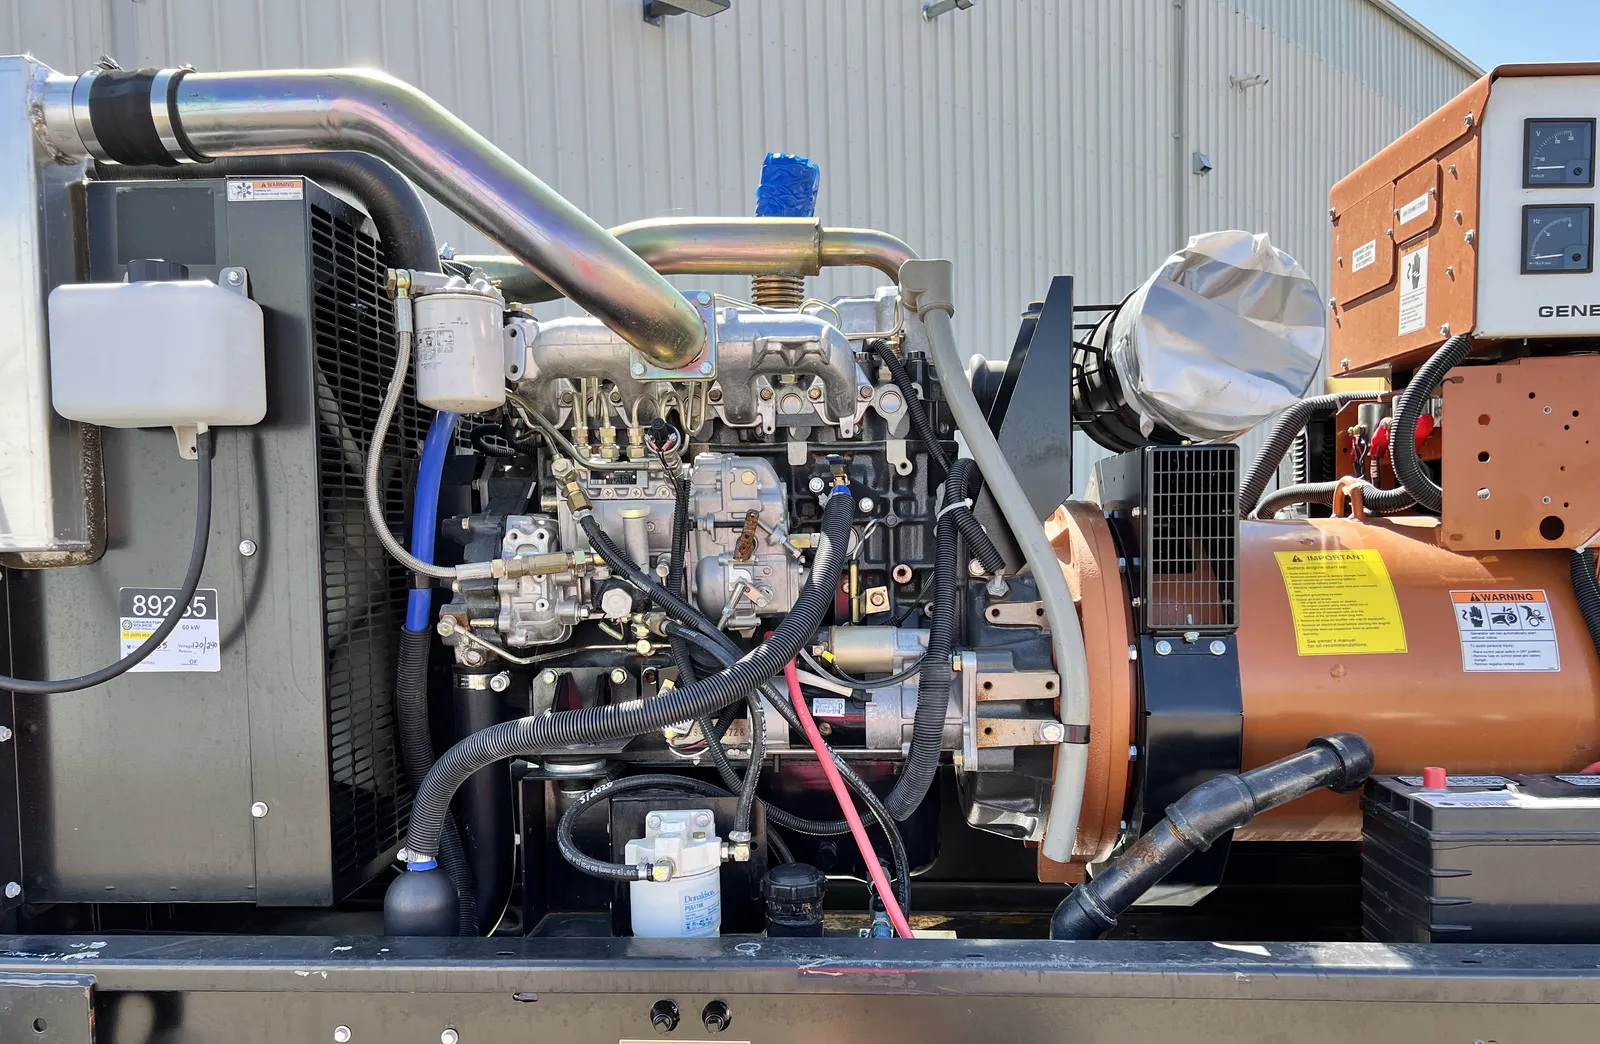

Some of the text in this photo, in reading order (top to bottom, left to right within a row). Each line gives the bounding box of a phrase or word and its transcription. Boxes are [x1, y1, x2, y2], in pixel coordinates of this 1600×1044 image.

[1538, 304, 1600, 318] GENE
[1480, 593, 1534, 602] WARNING
[684, 889, 716, 903] Donaldson
